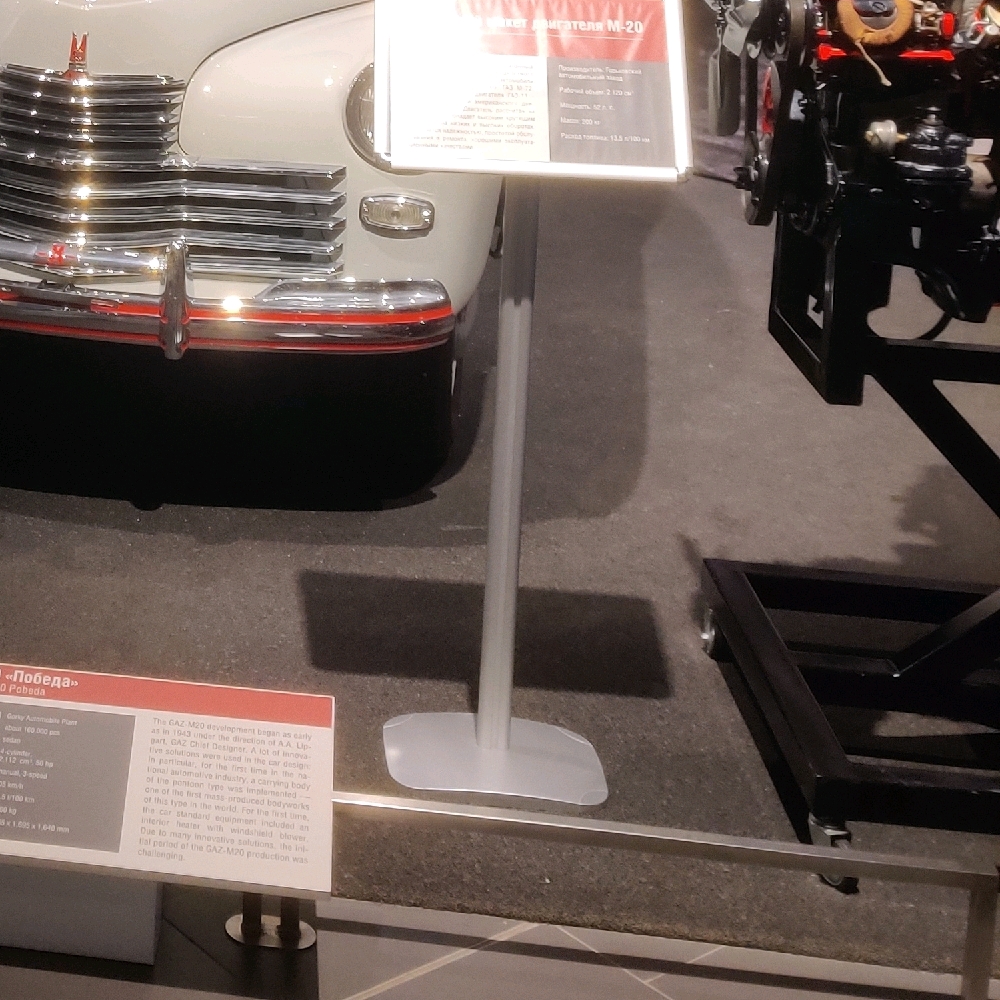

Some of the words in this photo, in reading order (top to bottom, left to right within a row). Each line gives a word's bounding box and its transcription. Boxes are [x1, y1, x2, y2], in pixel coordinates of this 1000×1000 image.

[532, 18, 603, 32] двигателя
[5, 669, 79, 690] «Победа»
[9, 684, 45, 696] Pobeda
